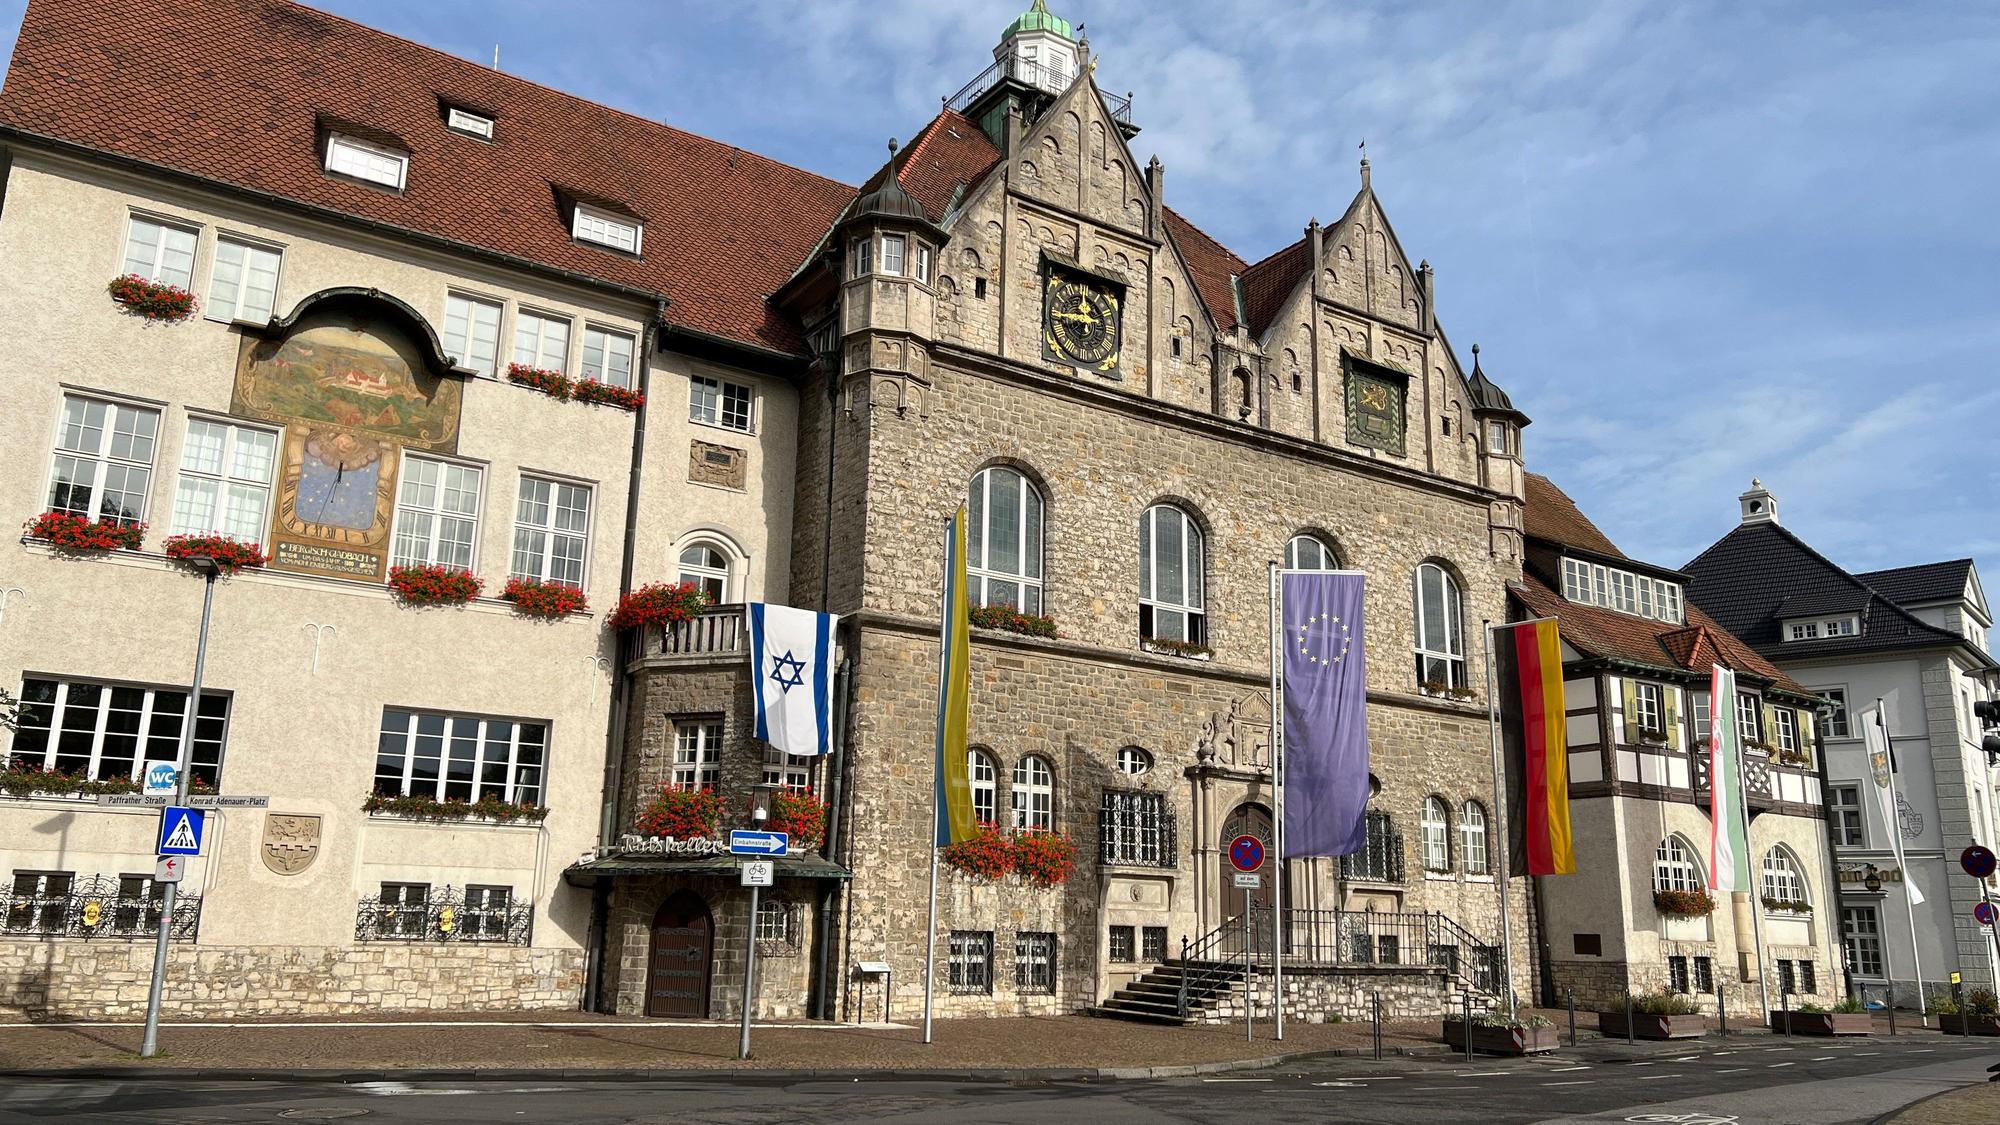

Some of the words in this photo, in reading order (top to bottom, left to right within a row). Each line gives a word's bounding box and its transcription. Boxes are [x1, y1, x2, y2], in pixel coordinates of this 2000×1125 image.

[151, 772, 175, 784] WC
[108, 796, 143, 805] Paffrather
[145, 796, 167, 805] Straße
[189, 797, 266, 806] Konrad-Adenauer-Platz
[621, 834, 724, 853] Ratskeller
[734, 839, 772, 847] Einbahnstraße
